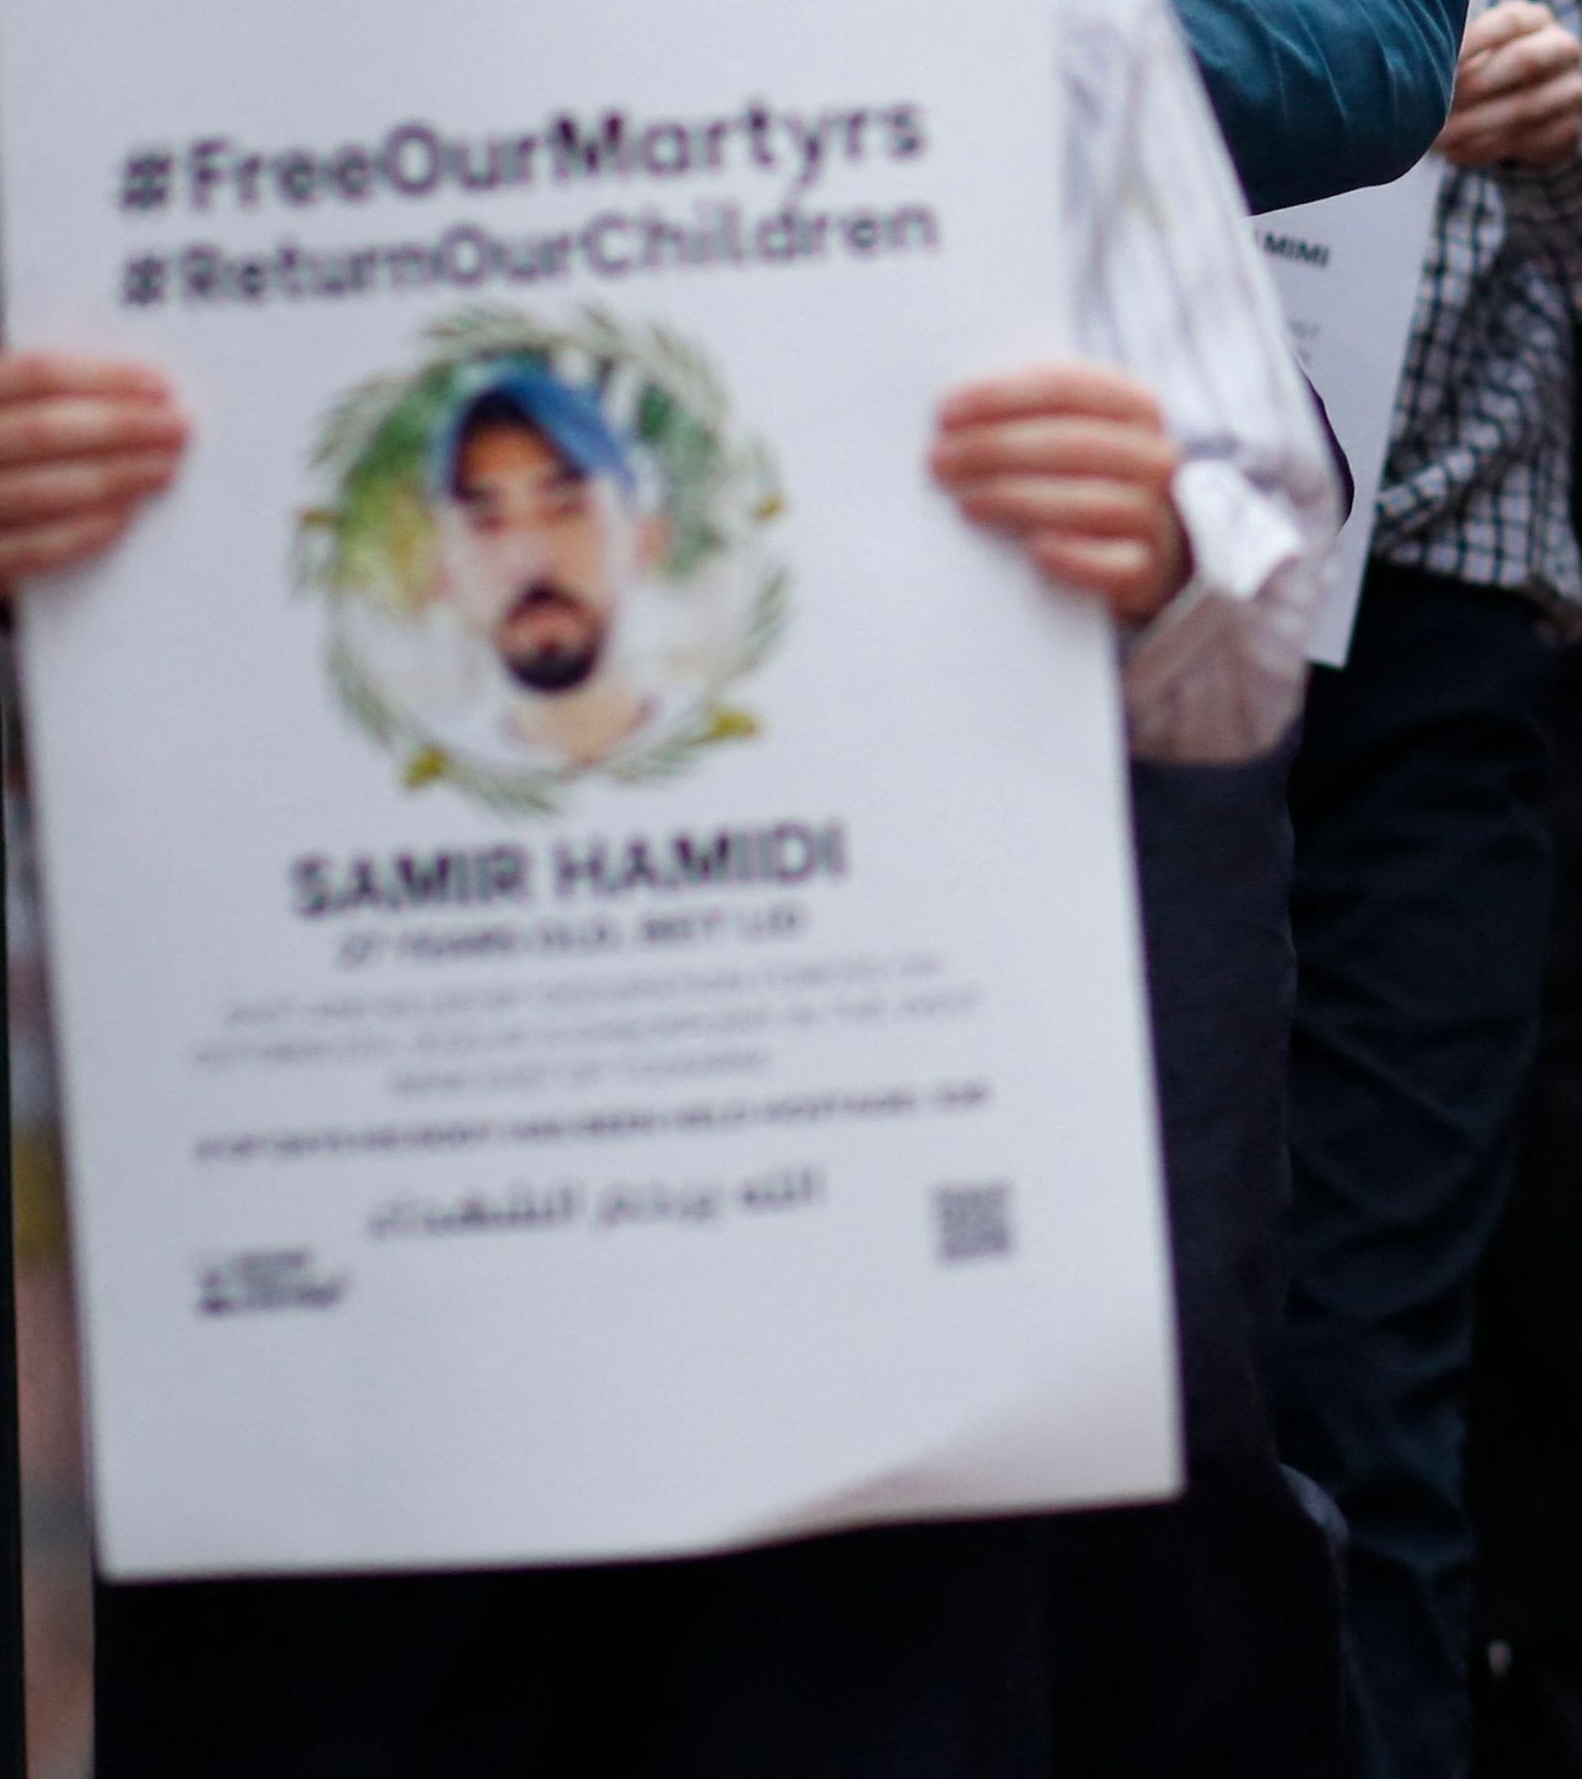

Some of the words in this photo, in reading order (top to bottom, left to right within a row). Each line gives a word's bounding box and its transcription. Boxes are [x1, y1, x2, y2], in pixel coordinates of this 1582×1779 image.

[119, 99, 926, 210] #FreeOurMartyrs
[119, 197, 940, 307] #ReturnOurChildren
[1256, 231, 1329, 267] MIMI
[293, 843, 530, 921] SAMIR
[555, 821, 847, 897] HAMIDI
